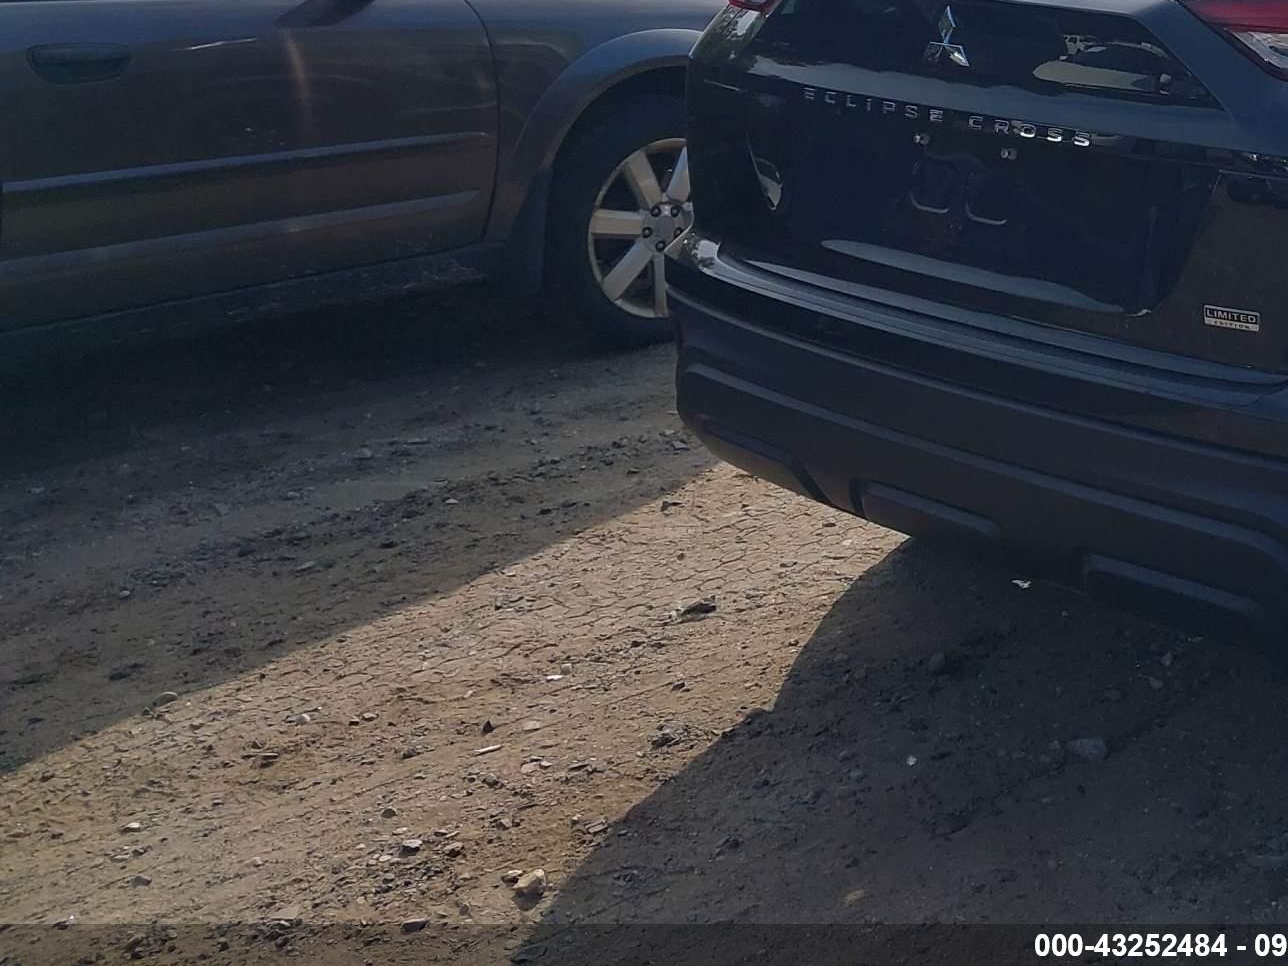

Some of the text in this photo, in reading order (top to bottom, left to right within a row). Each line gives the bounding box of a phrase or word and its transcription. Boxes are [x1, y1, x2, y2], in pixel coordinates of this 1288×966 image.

[803, 87, 1092, 147] ECLIPSE CROSS
[1206, 309, 1257, 323] LIMITED
